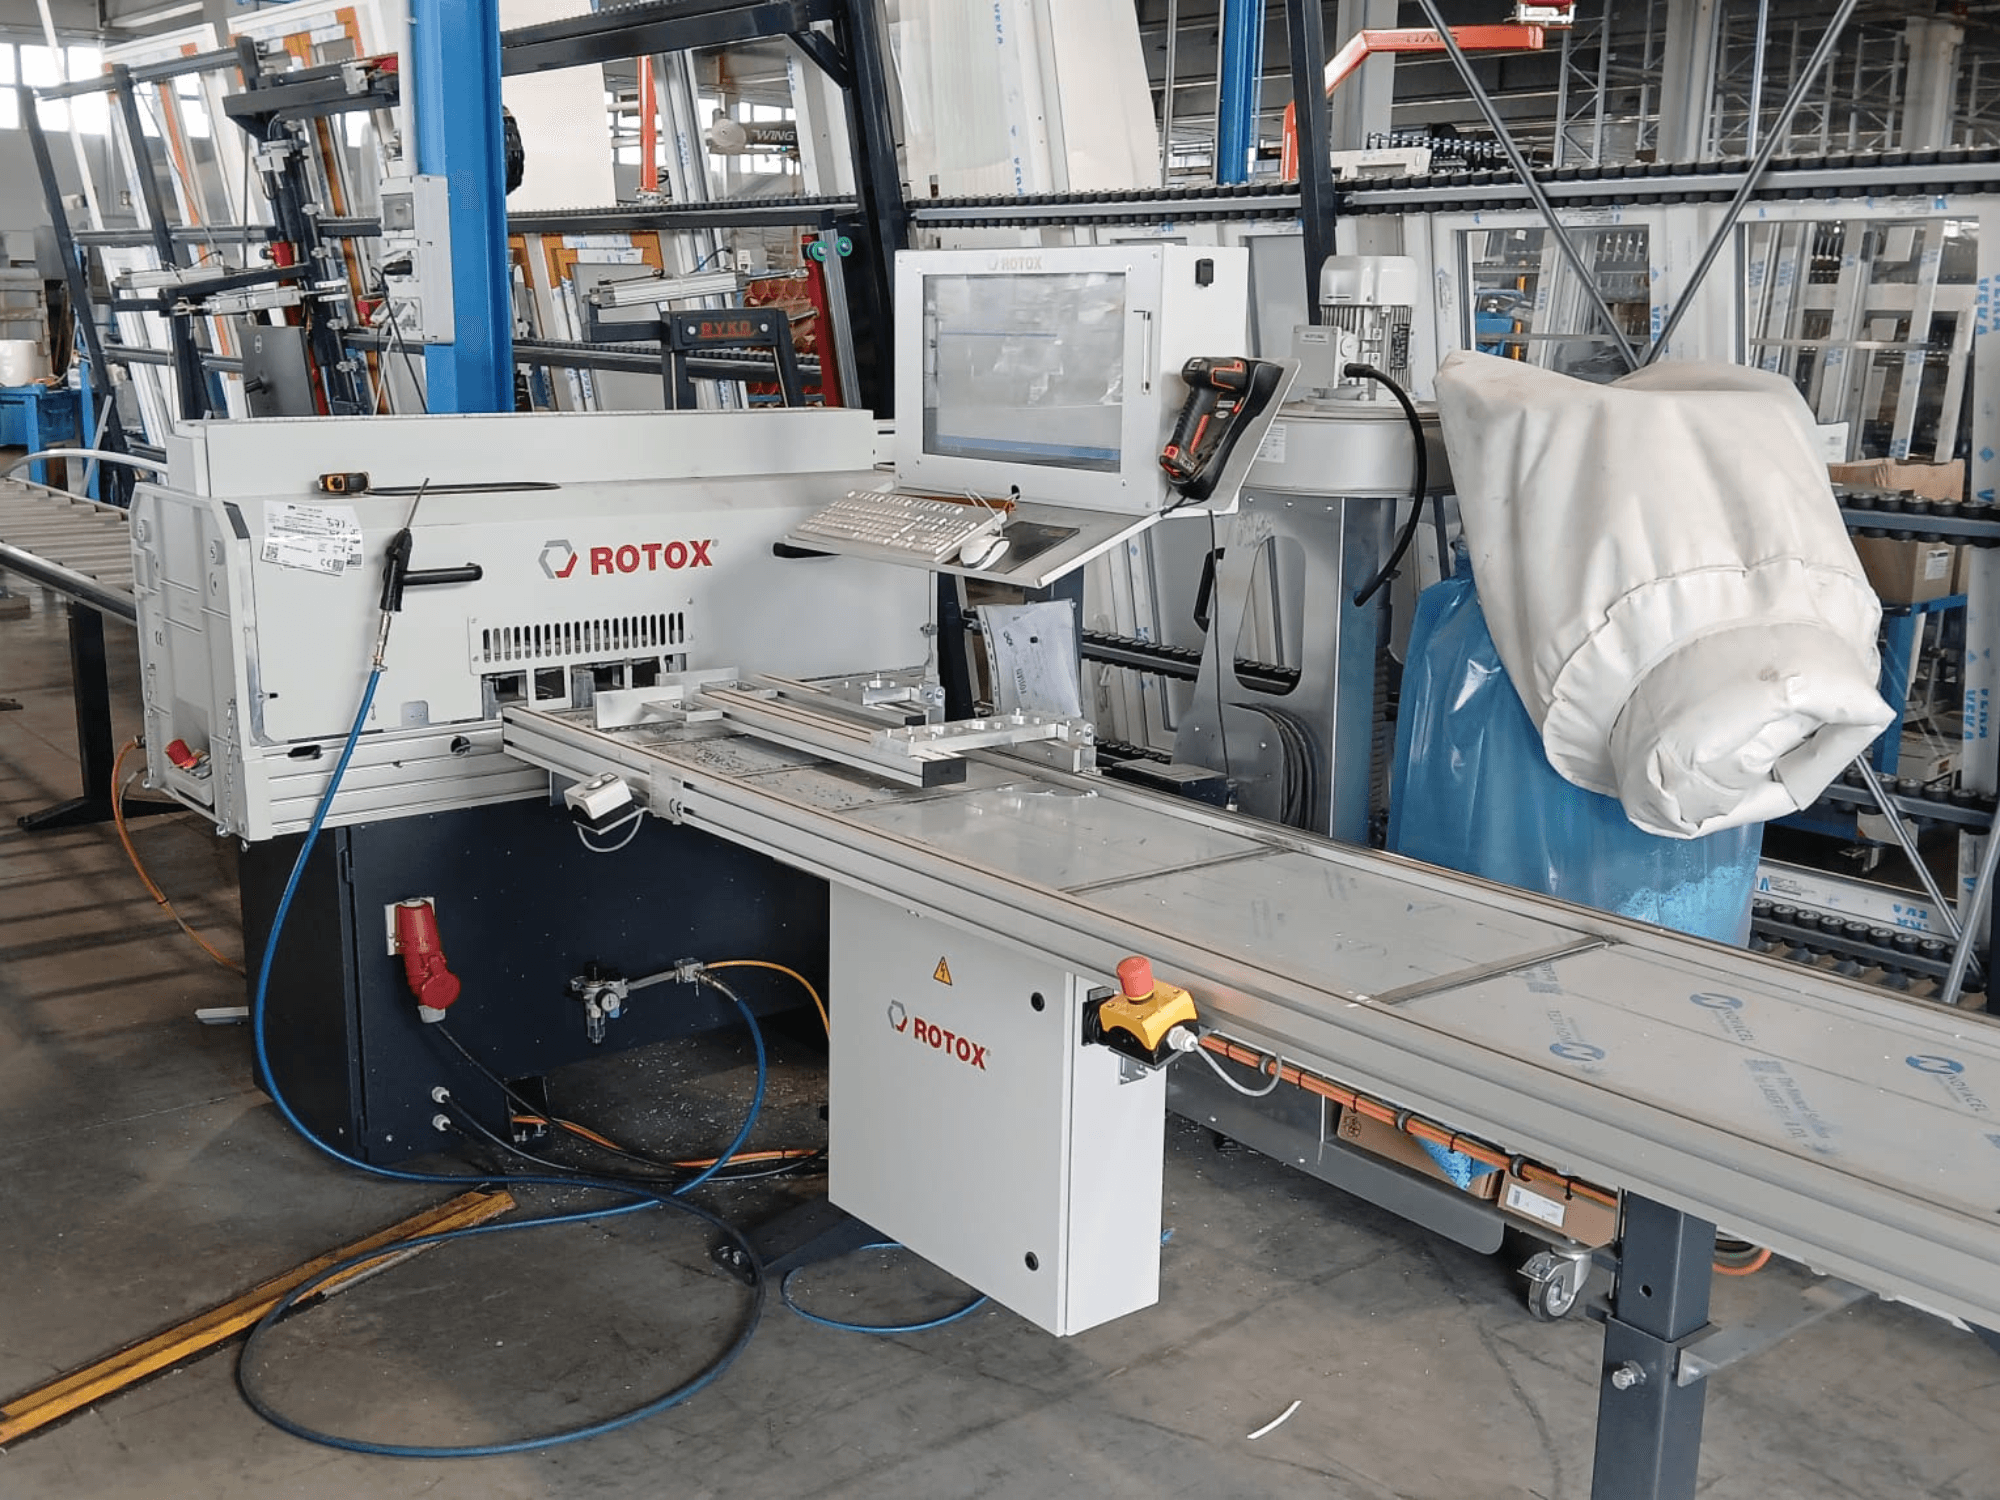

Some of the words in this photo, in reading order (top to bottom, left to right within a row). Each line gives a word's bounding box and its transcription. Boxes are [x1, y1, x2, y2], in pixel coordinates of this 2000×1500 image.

[1002, 254, 1043, 271] ROTOX
[590, 539, 713, 576] ROTOX
[914, 1016, 986, 1071] ROTOX
